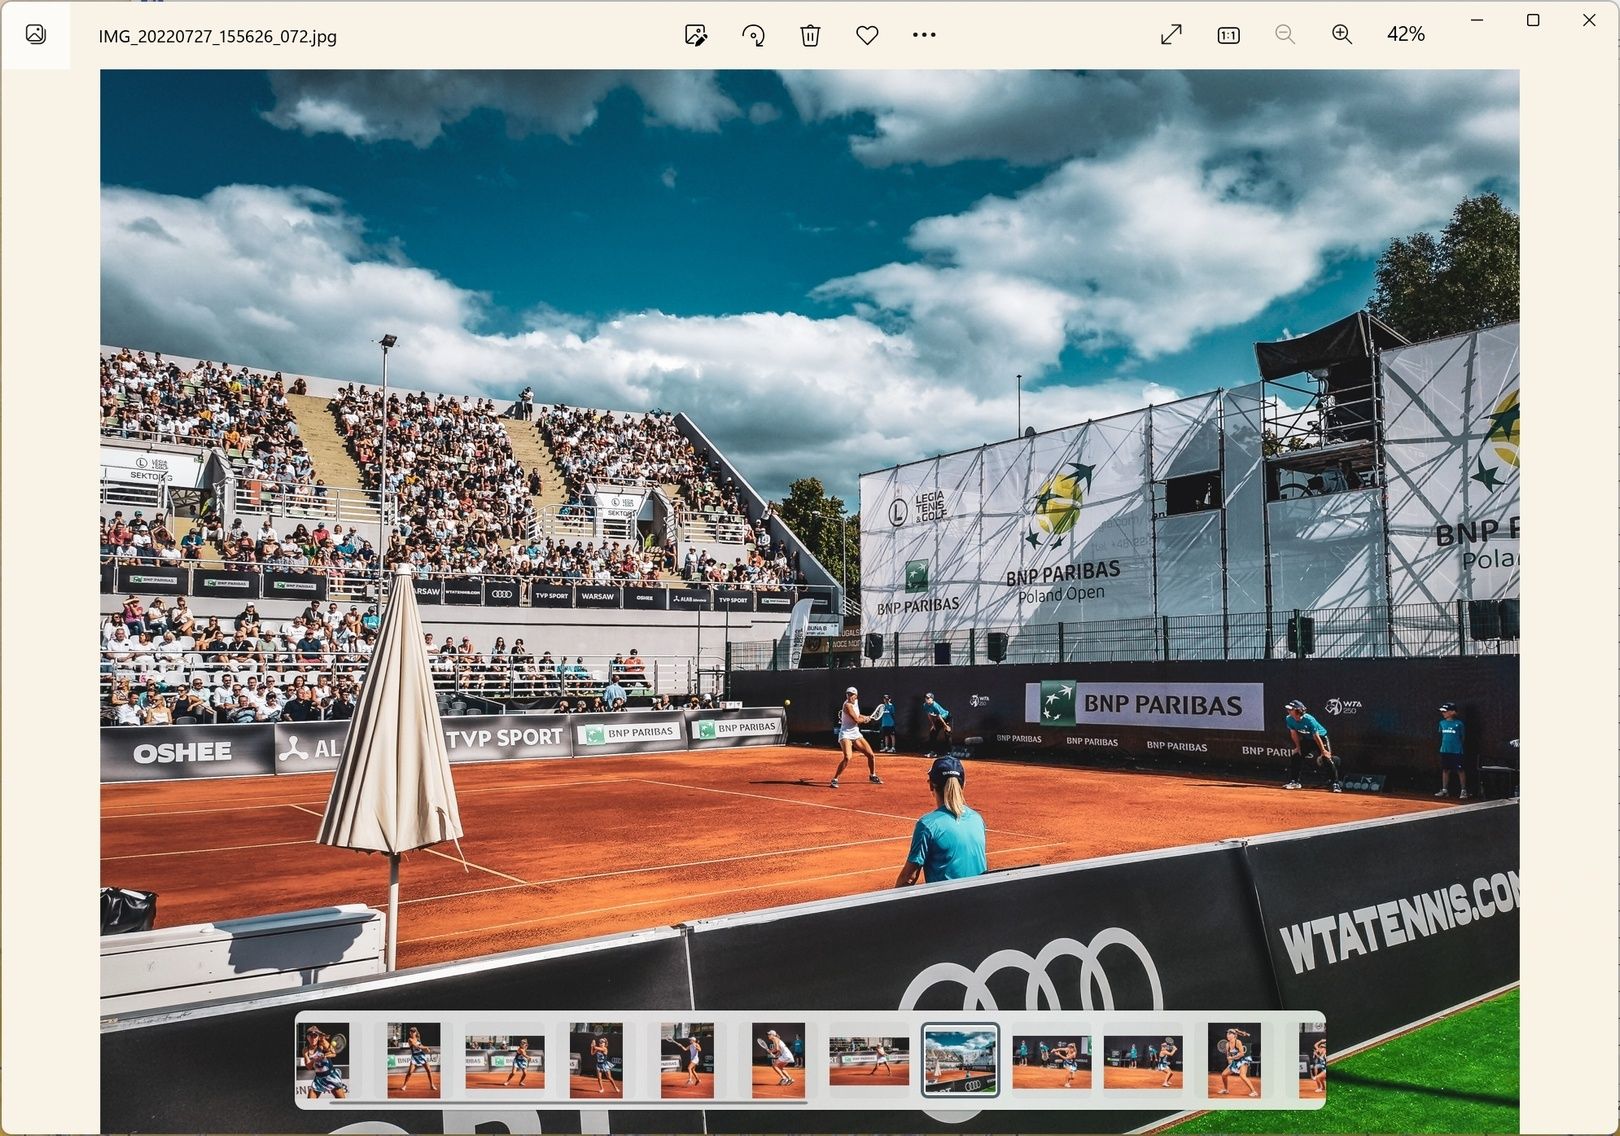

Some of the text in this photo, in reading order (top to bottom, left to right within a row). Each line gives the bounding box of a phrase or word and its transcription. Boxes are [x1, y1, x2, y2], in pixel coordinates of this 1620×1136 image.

[99, 28, 338, 48] IMG_20220727_155626_072.jpg
[1387, 25, 1426, 42] 42%
[916, 490, 944, 504] LEGIA
[916, 500, 944, 513] TENIS
[921, 509, 948, 522] GOLF
[1436, 519, 1499, 547] BNP
[1463, 549, 1519, 570] Pola
[1006, 560, 1121, 587] BNP PARIBAS
[1019, 586, 1105, 604] Poland Open
[877, 596, 960, 616] BNP PARIBAS
[1085, 694, 1243, 716] BNP PARIBAS
[609, 727, 674, 738] BNP PARIBAS
[718, 722, 777, 734] BNP PARIBAS
[446, 728, 564, 749] TVP SPORT
[1011, 735, 1042, 743] PARIBAS
[1066, 737, 1119, 747] BNP PARIBAS
[1146, 741, 1208, 752] BNP PARIBAS
[133, 741, 232, 765] OSHEE
[1242, 746, 1264, 756] BNP
